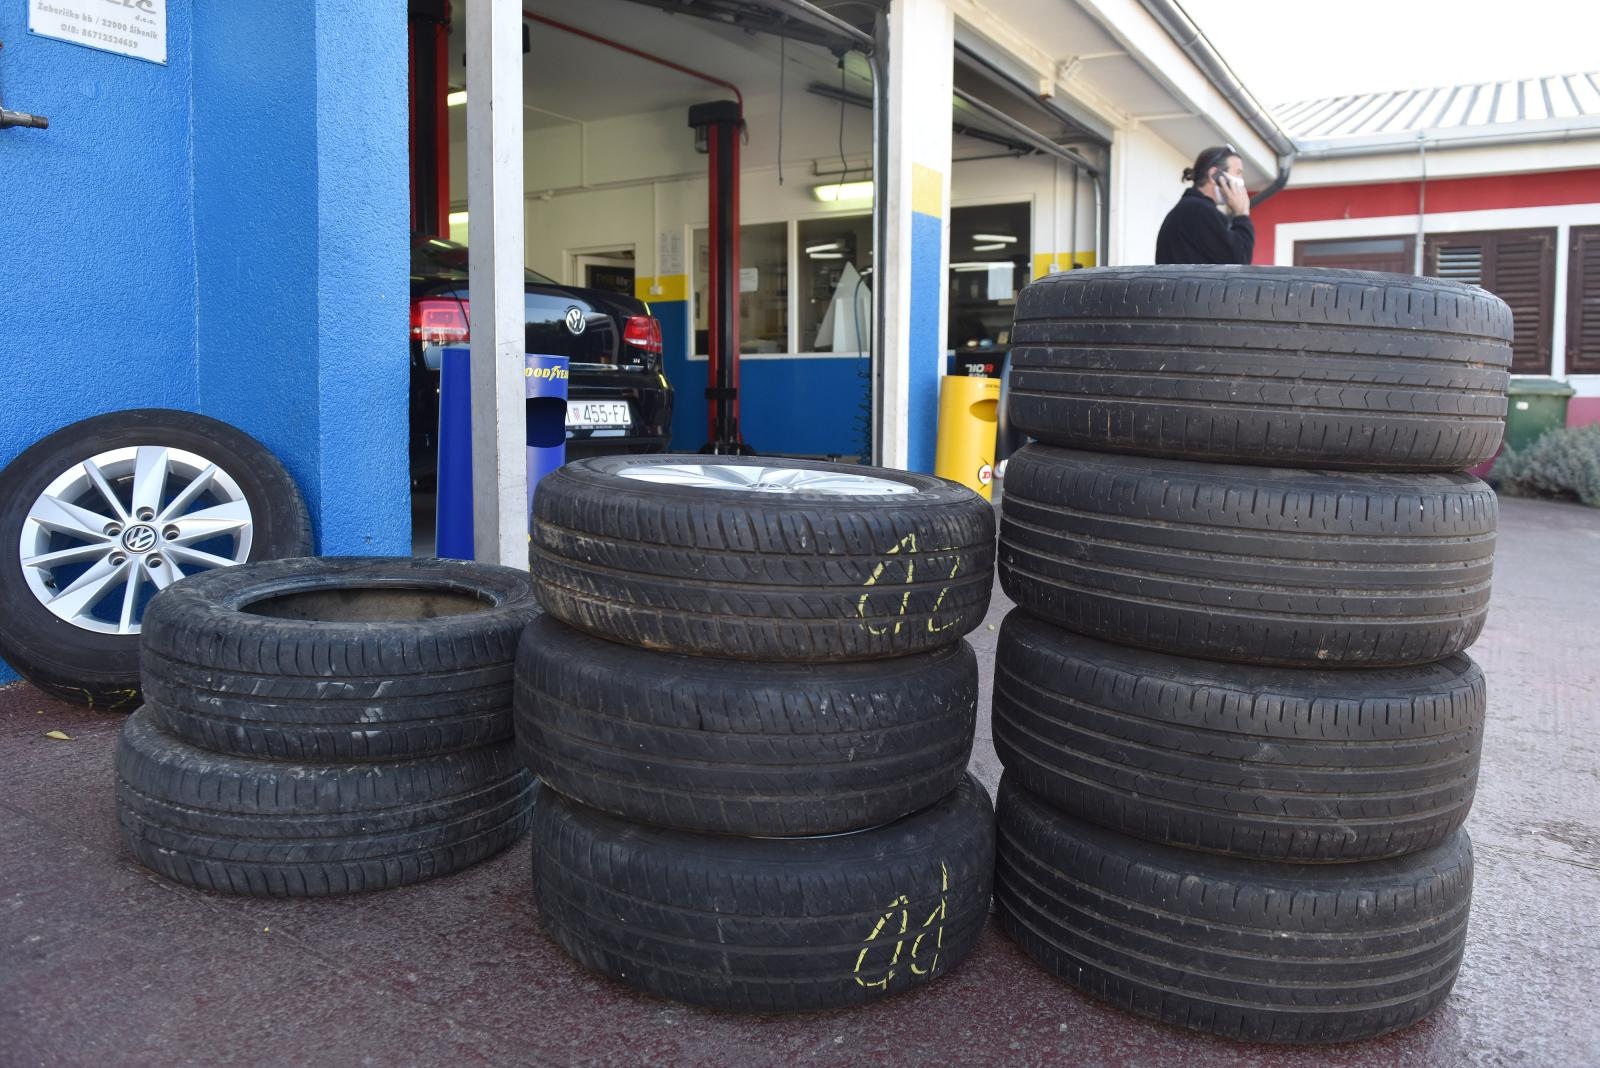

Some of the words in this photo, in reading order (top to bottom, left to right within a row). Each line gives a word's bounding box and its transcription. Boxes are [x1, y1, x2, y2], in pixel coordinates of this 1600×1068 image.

[61, 24, 79, 34] OIB:
[101, 19, 127, 31] 22000
[129, 24, 158, 40] Šibenik
[525, 366, 569, 381] OODYE
[584, 404, 629, 423] 455-FZ
